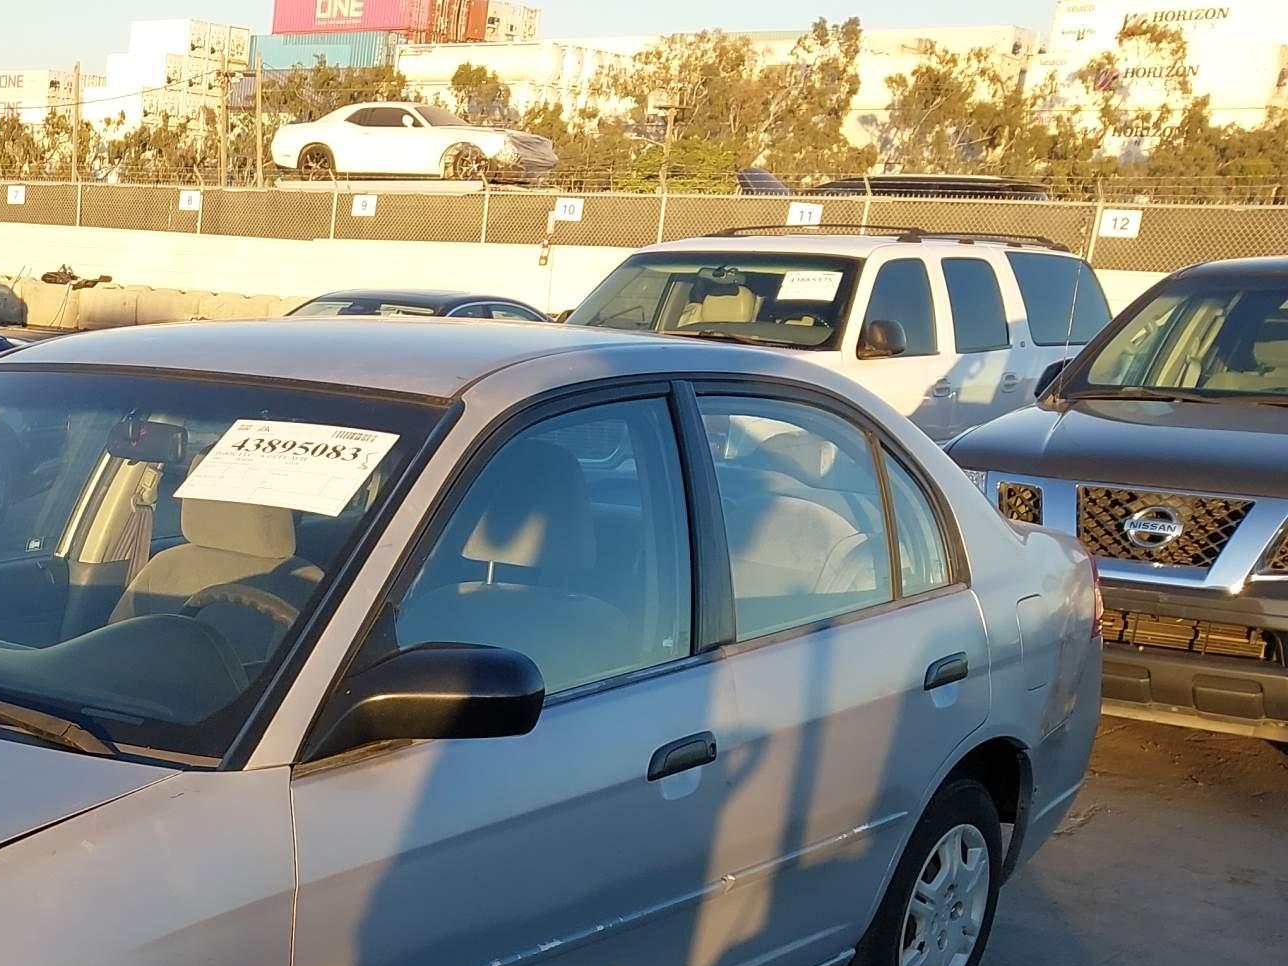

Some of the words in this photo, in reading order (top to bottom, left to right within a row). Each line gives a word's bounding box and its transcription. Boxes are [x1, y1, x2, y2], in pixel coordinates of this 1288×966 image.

[315, 0, 363, 18] ONE
[1152, 7, 1231, 22] HORIZON
[1123, 64, 1201, 79] HORIZON
[0, 74, 24, 88] ONE
[361, 200, 368, 211] 9
[562, 204, 576, 215] 10
[799, 210, 812, 223] 11
[1112, 215, 1130, 230] 12
[231, 437, 363, 462] 43895083
[1129, 520, 1177, 533] NISSAN
